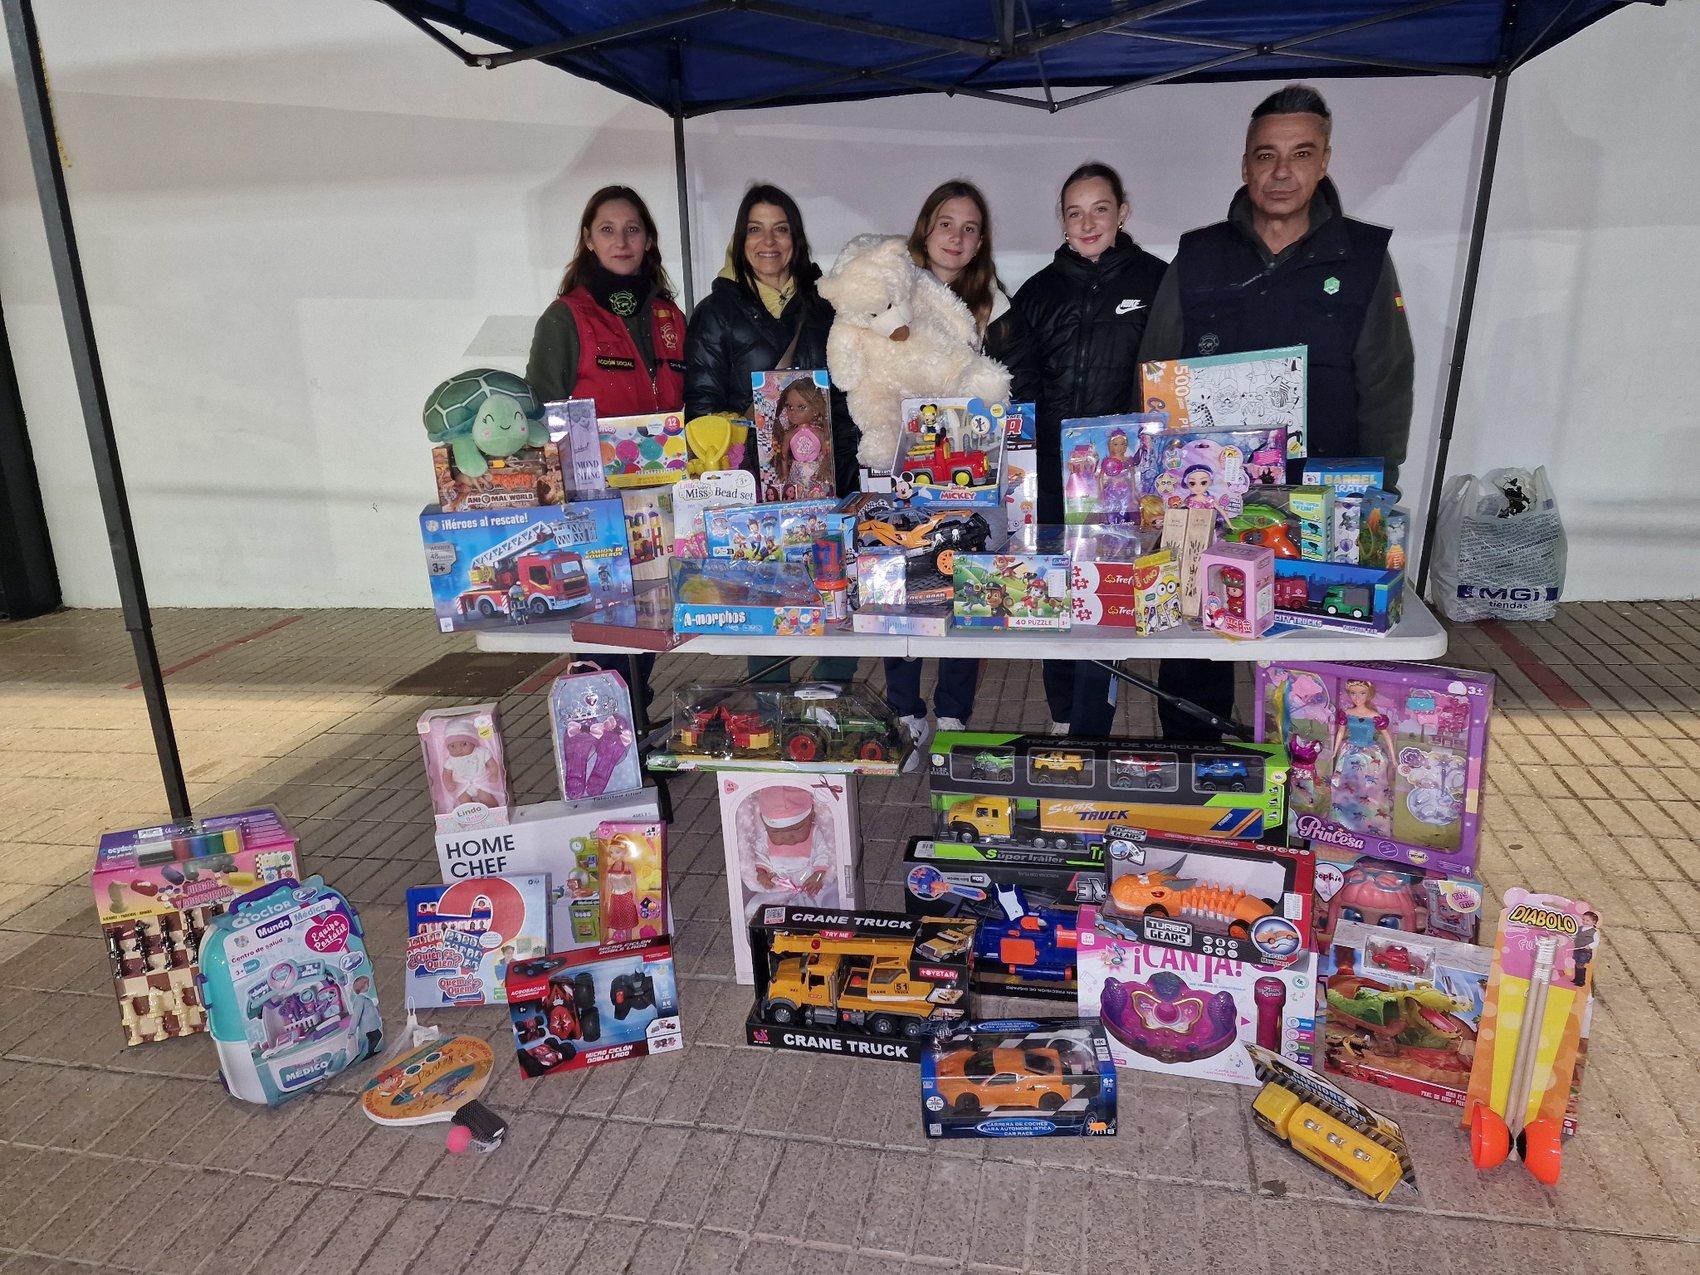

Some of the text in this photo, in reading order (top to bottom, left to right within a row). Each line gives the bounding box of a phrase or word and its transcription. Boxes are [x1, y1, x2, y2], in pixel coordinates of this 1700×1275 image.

[1121, 299, 1142, 308] NIKE
[616, 360, 634, 368] SOCIAL
[1174, 365, 1191, 397] 500
[667, 418, 678, 426] 12
[1324, 474, 1377, 485] BARREL
[686, 486, 753, 500] Miss Bead set
[940, 492, 976, 500] MICKEY
[441, 512, 529, 531] ¡Héroes al rescate!
[431, 563, 446, 574] 3+
[1115, 575, 1134, 585] Tref
[1143, 569, 1158, 584] UNO
[1489, 601, 1528, 610] tiendas
[684, 612, 746, 628] A-morphos
[1274, 615, 1323, 628] CITY TRUCKS
[456, 805, 483, 818] Lindo
[1075, 809, 1130, 821] TRUCK
[1297, 816, 1364, 849] Princesa
[446, 834, 516, 860] HOME
[450, 856, 508, 879] CHEF
[257, 904, 327, 938] Mundo Médico
[791, 913, 913, 930] CRANE TRUCK
[1509, 905, 1577, 934] DIABOLO
[824, 930, 838, 938] TRY
[1150, 922, 1189, 934] TURBO
[1150, 930, 1187, 944] GEARS
[232, 938, 284, 964] Centro de salud
[1134, 945, 1244, 984] ¡CANTA!
[895, 983, 908, 992] 51
[586, 1045, 633, 1058] MICRO CICLÓN
[782, 1032, 909, 1058] CRANE TRUCK
[286, 1061, 328, 1082] MÉDICO
